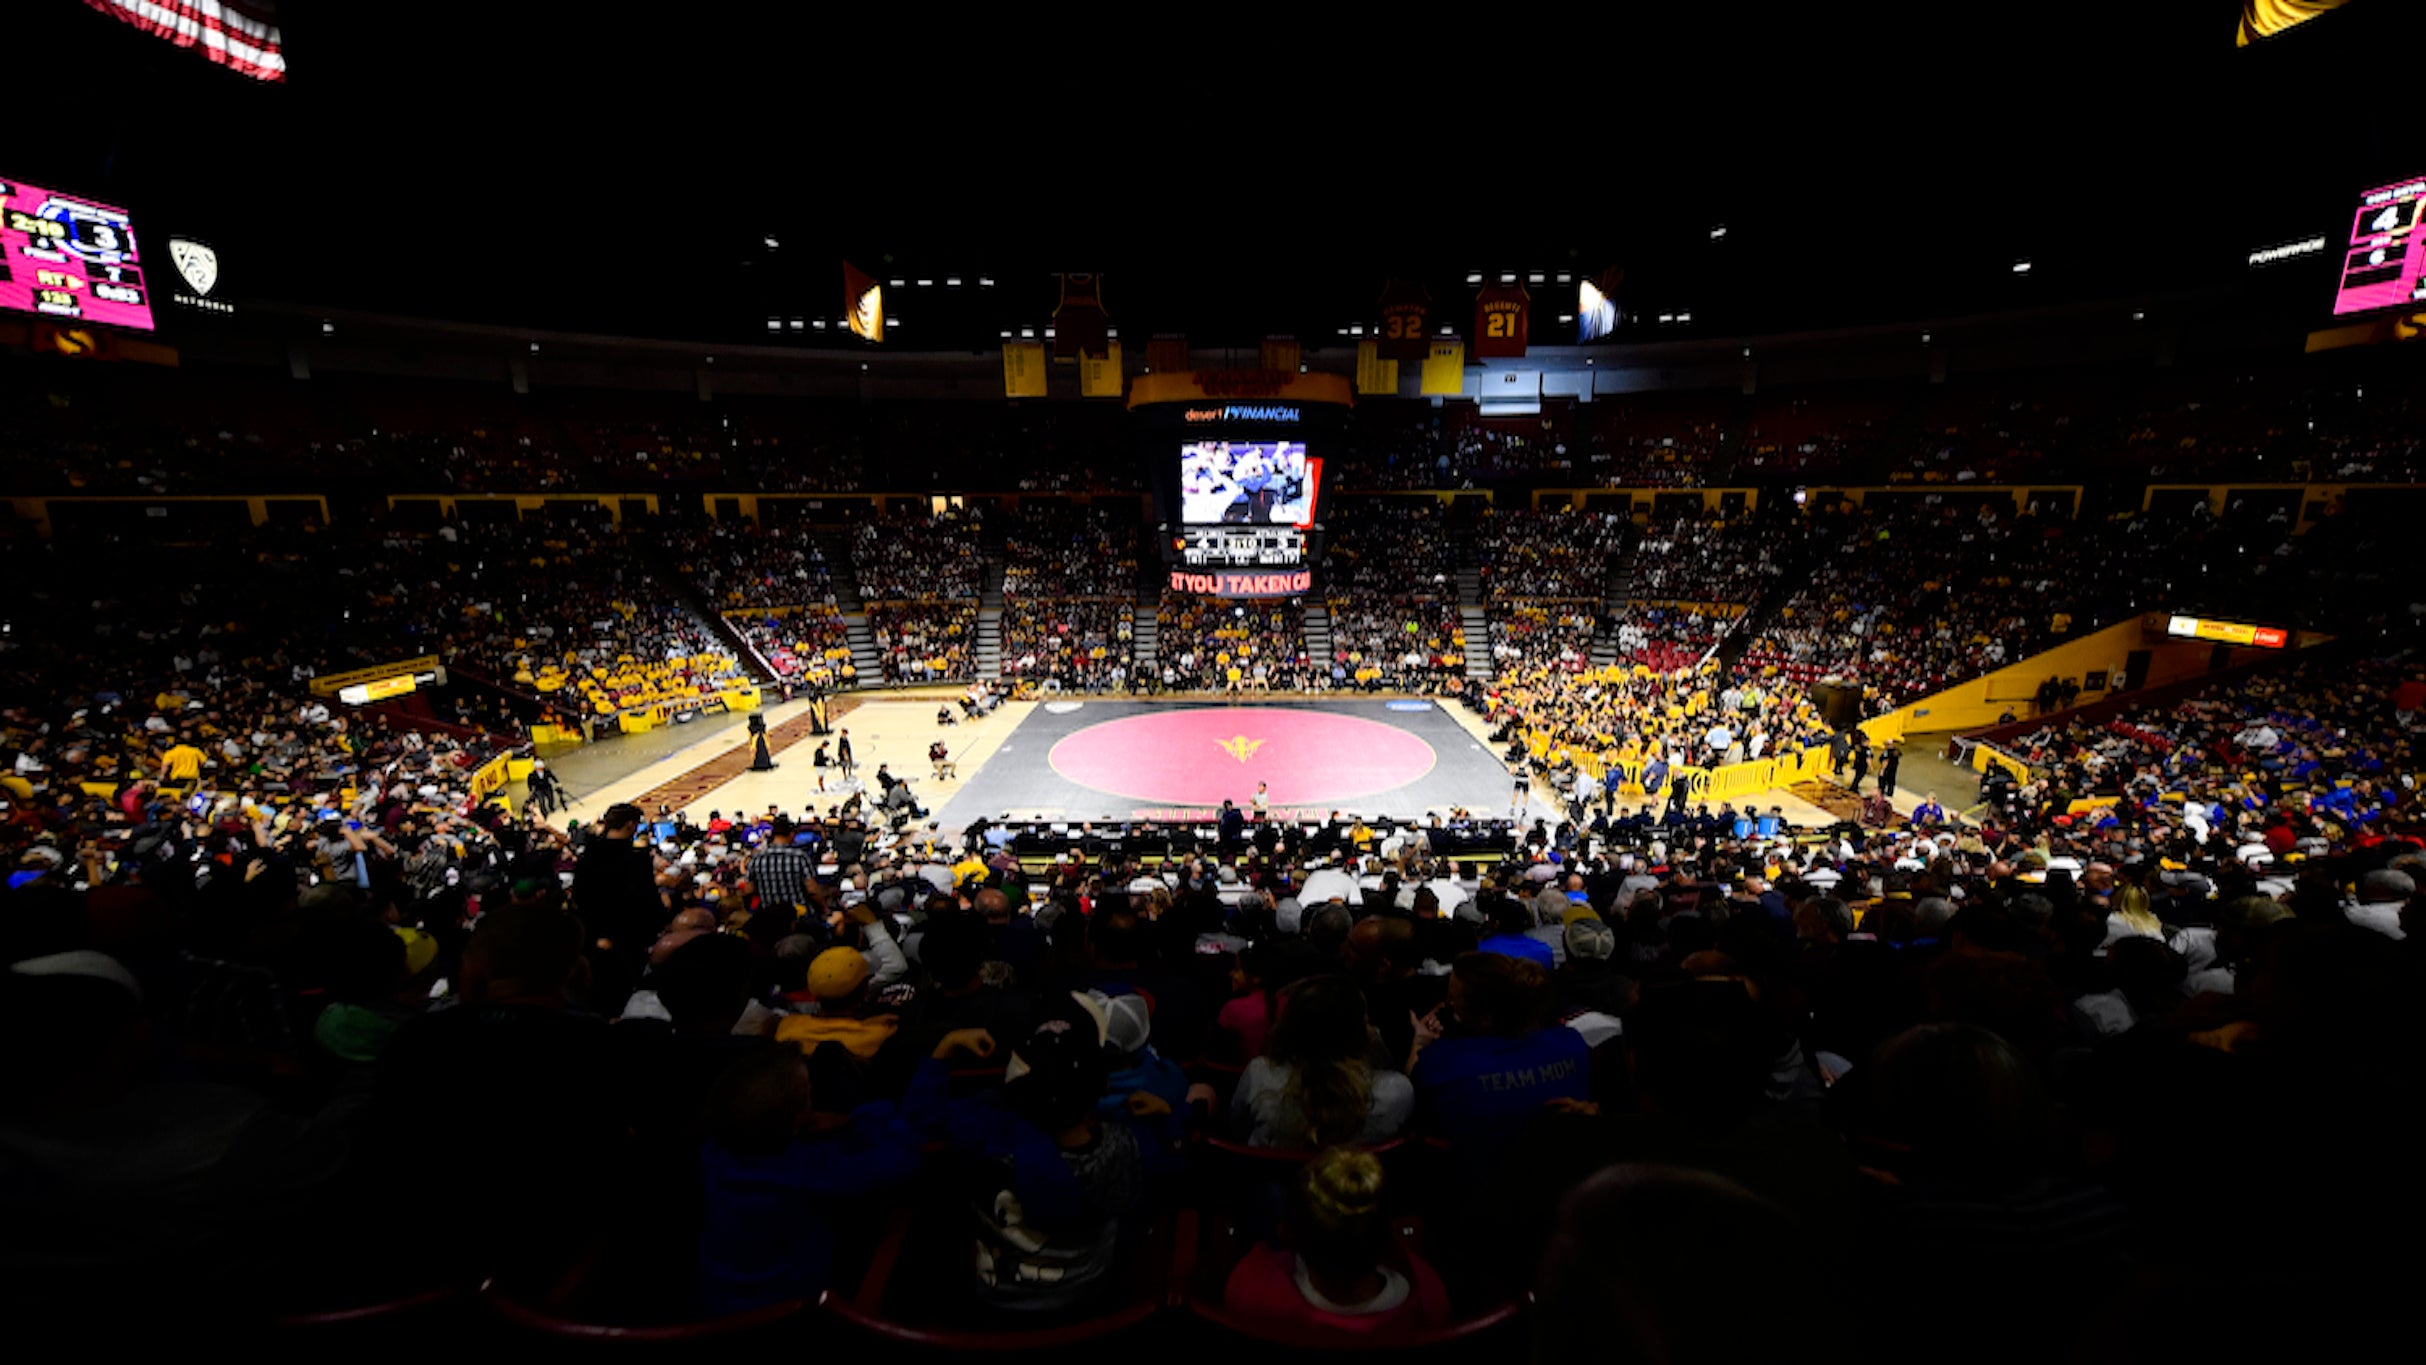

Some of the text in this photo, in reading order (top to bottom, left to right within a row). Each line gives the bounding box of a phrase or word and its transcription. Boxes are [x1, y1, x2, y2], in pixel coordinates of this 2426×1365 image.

[10, 213, 66, 239] 2:10
[2371, 205, 2399, 231] 4
[93, 225, 119, 250] 3
[105, 266, 121, 283] 7
[1387, 315, 1422, 339] 32
[1486, 312, 1516, 338] 21
[1184, 573, 1224, 594] YOU
[1226, 573, 1293, 593] TAKEN
[1478, 1057, 1577, 1092] TEAM MOM
